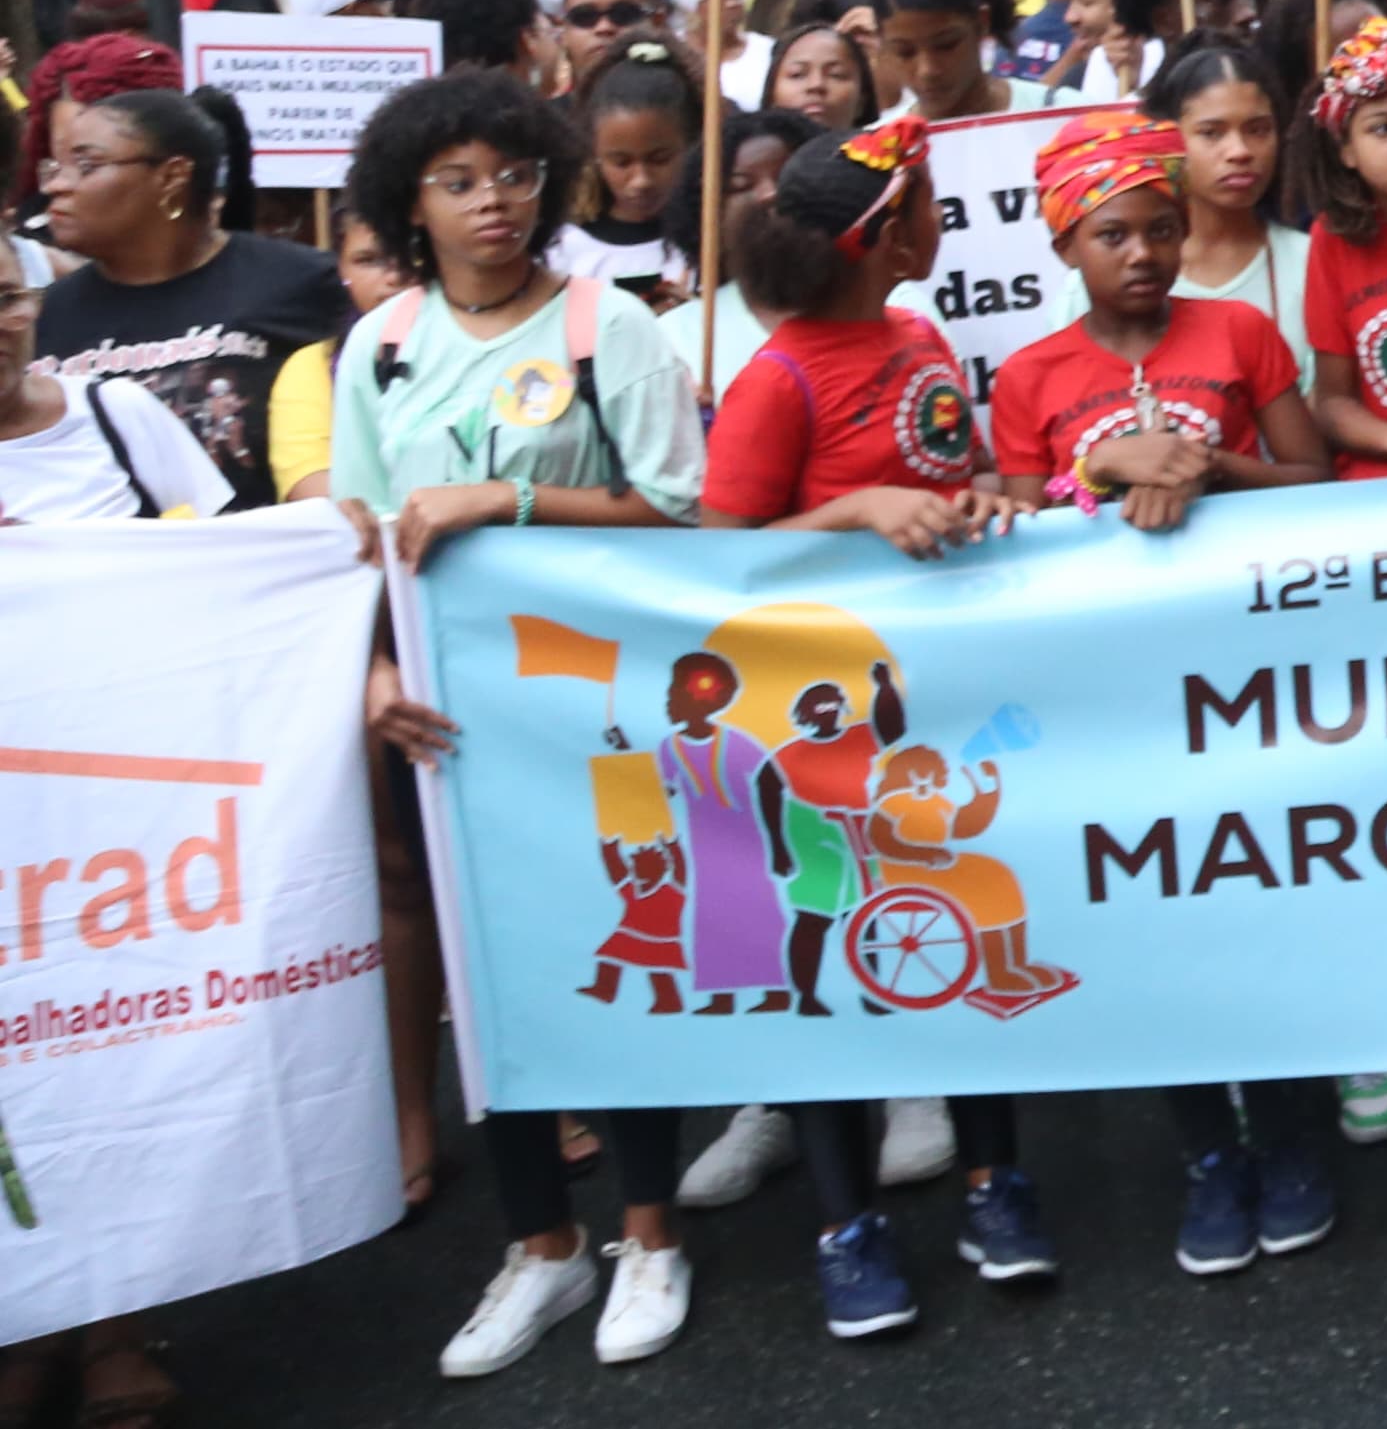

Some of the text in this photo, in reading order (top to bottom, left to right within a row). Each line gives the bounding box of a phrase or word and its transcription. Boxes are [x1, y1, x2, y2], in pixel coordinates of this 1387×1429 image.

[934, 270, 1043, 322] das
[1247, 556, 1352, 615] 12ª
[0, 796, 243, 966] rad
